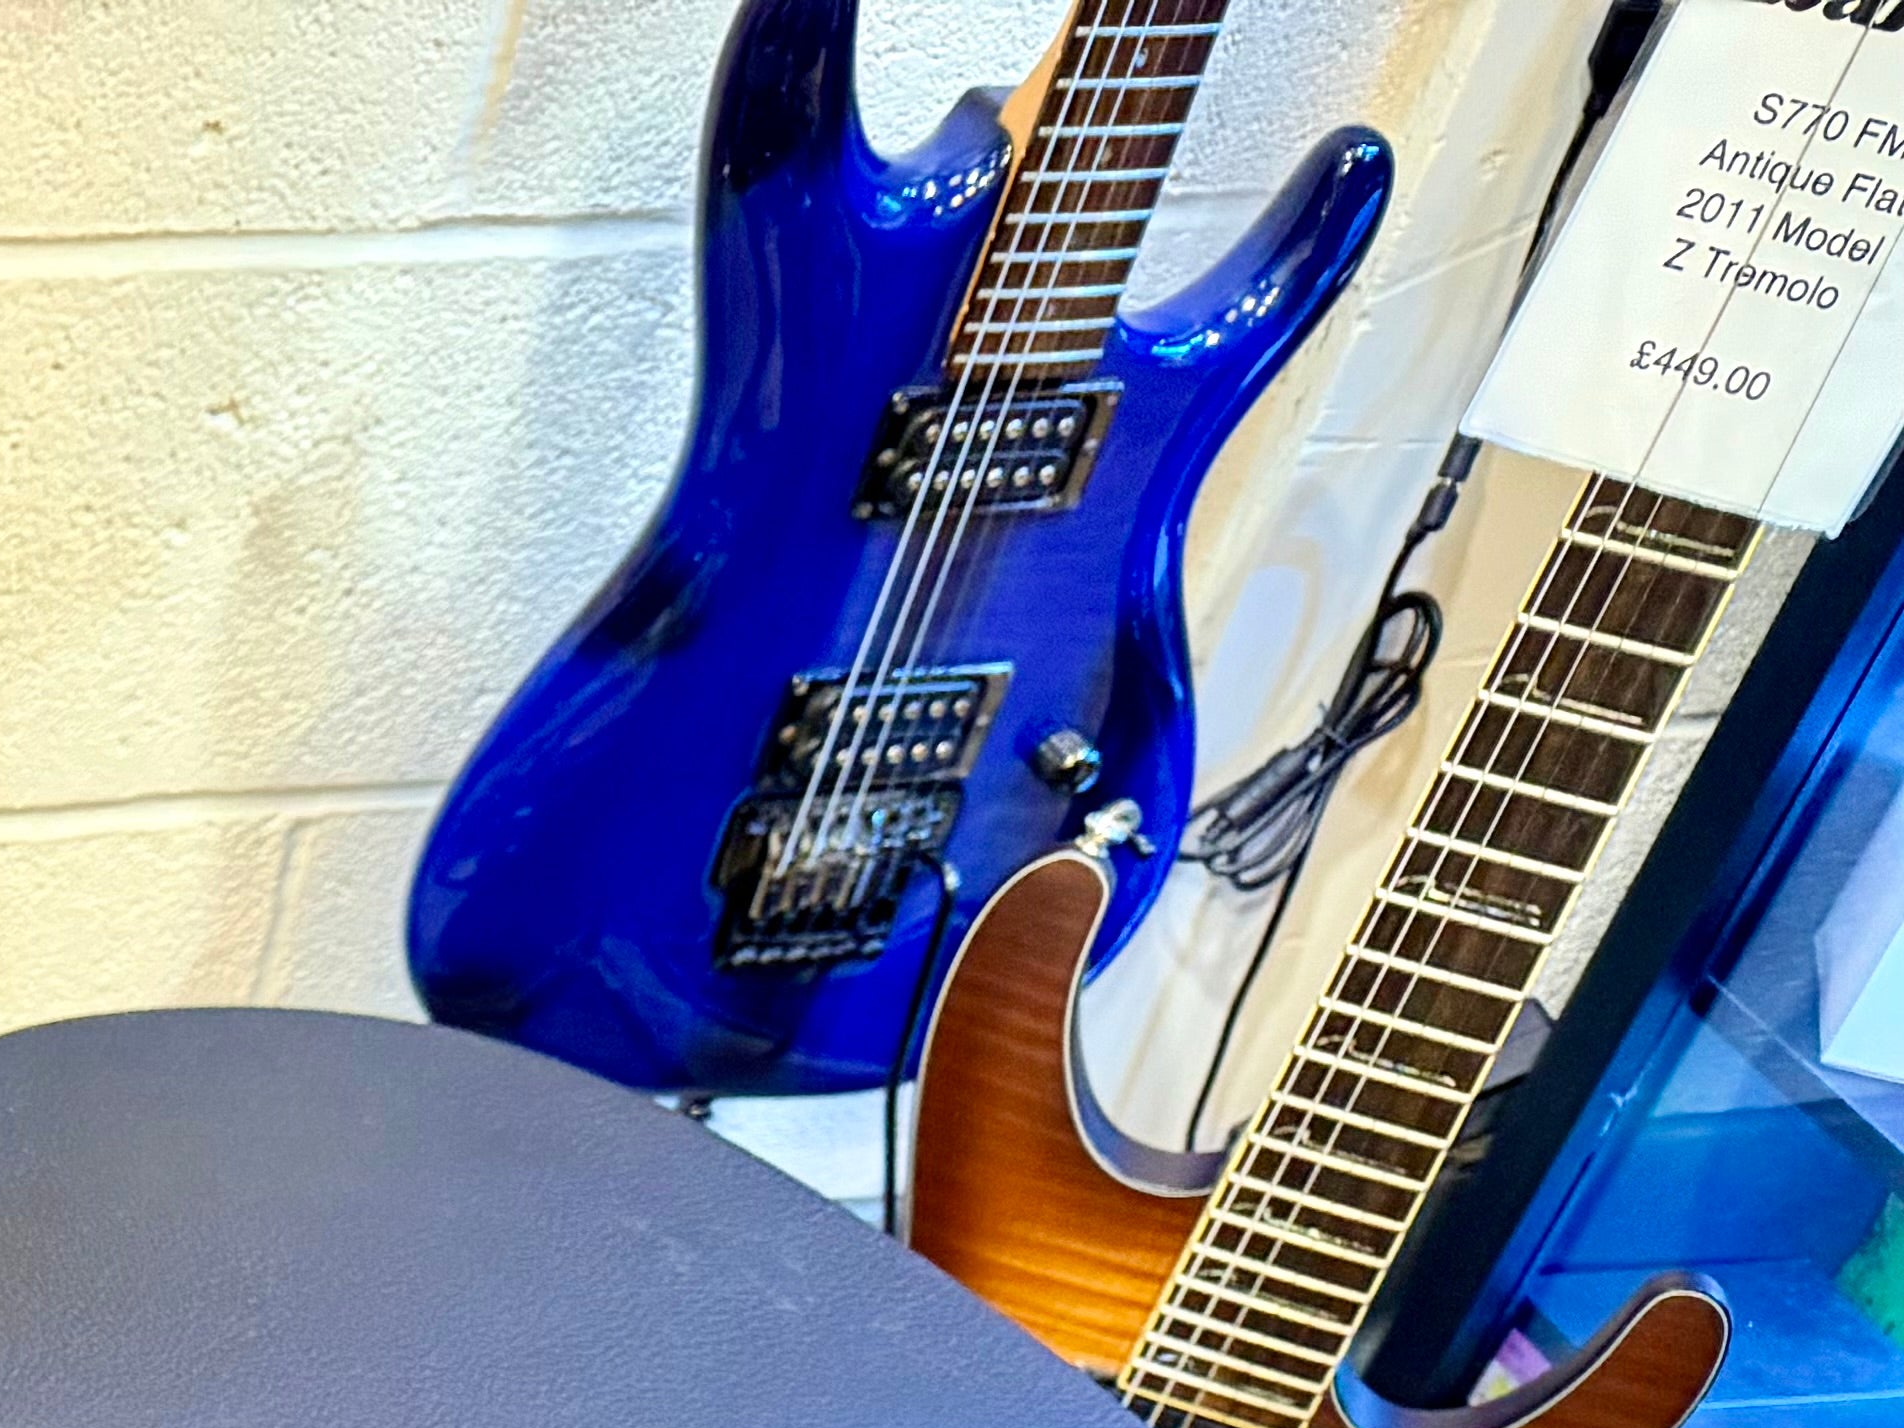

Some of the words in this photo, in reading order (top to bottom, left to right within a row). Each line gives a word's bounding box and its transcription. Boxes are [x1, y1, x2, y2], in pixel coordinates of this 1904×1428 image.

[1754, 93, 1849, 141] S770
[1699, 138, 1834, 196] Antique
[1676, 188, 1764, 234] 2011
[1772, 211, 1885, 265] Model
[1663, 237, 1695, 271] Z
[1704, 246, 1839, 309] Tremolo
[1630, 340, 1771, 400] £449.00
